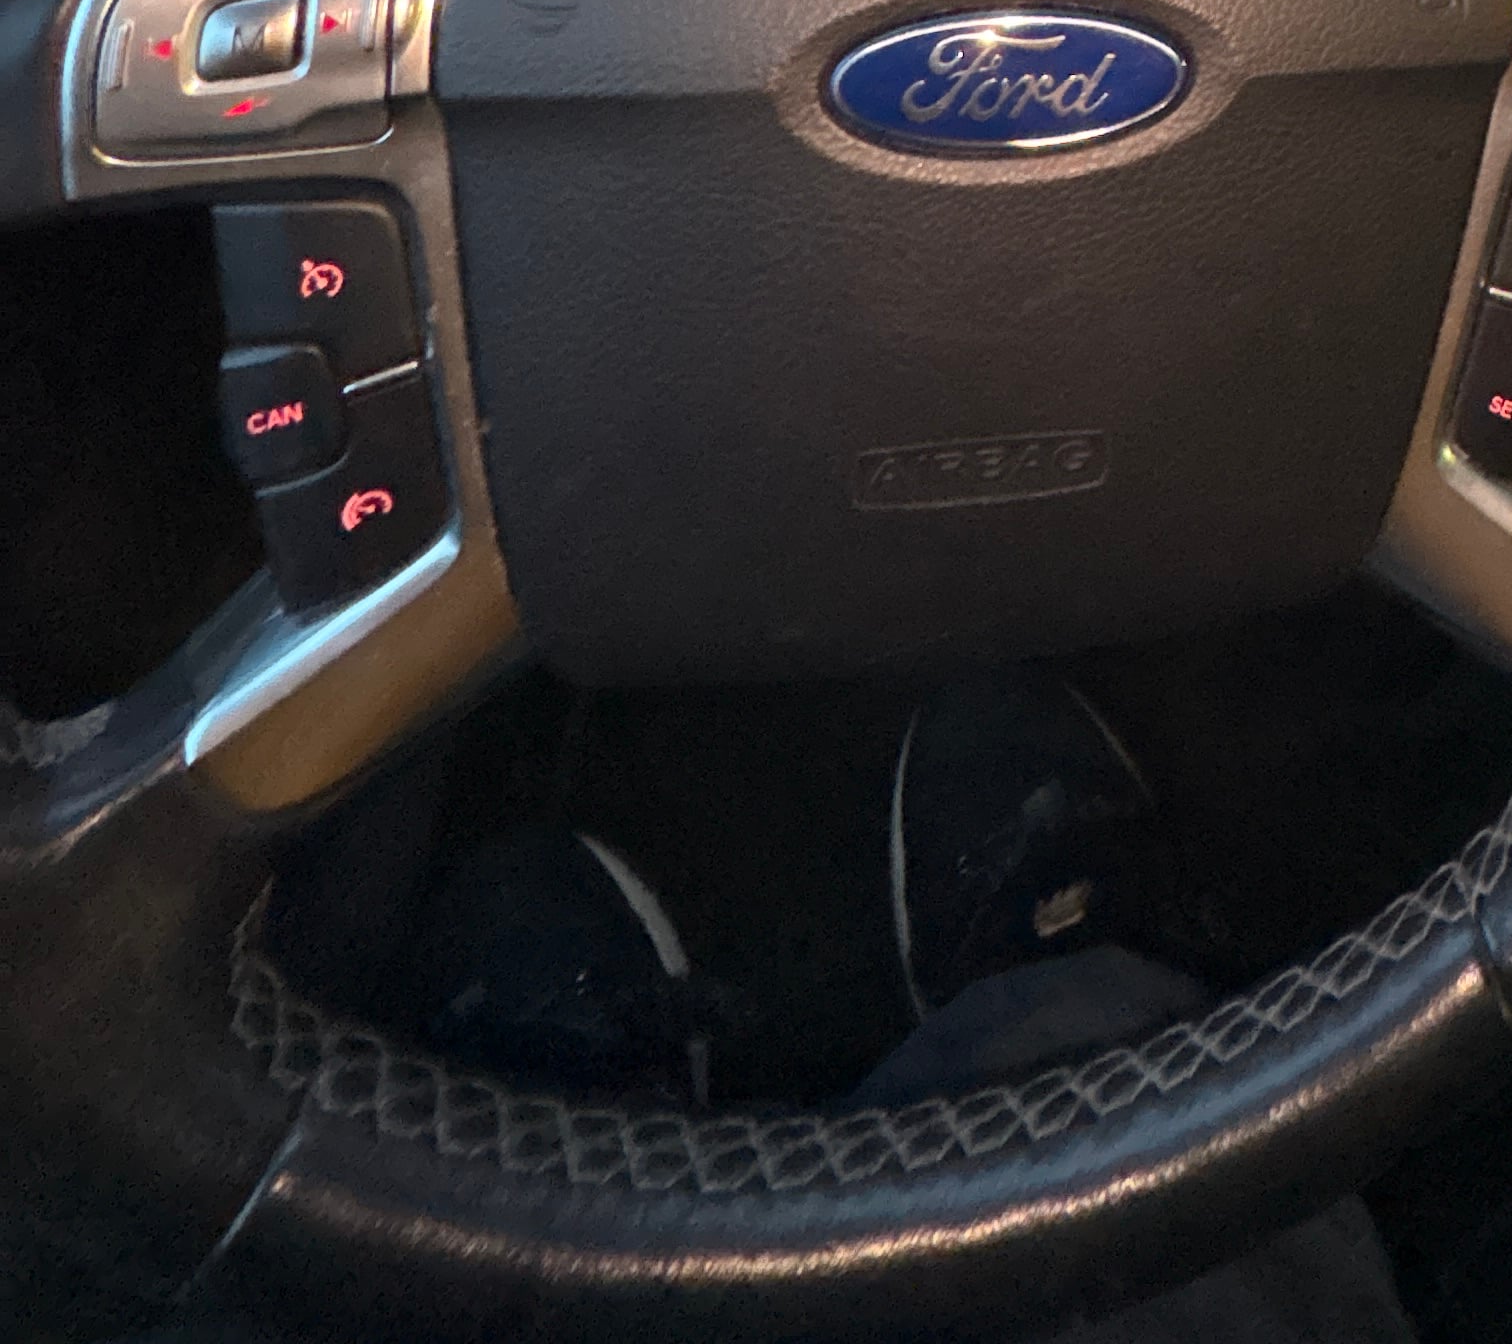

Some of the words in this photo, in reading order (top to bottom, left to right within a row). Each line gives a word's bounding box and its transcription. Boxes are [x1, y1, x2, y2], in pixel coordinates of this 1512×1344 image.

[231, 24, 265, 54] M
[902, 34, 1118, 123] Ford
[246, 400, 305, 435] CAN
